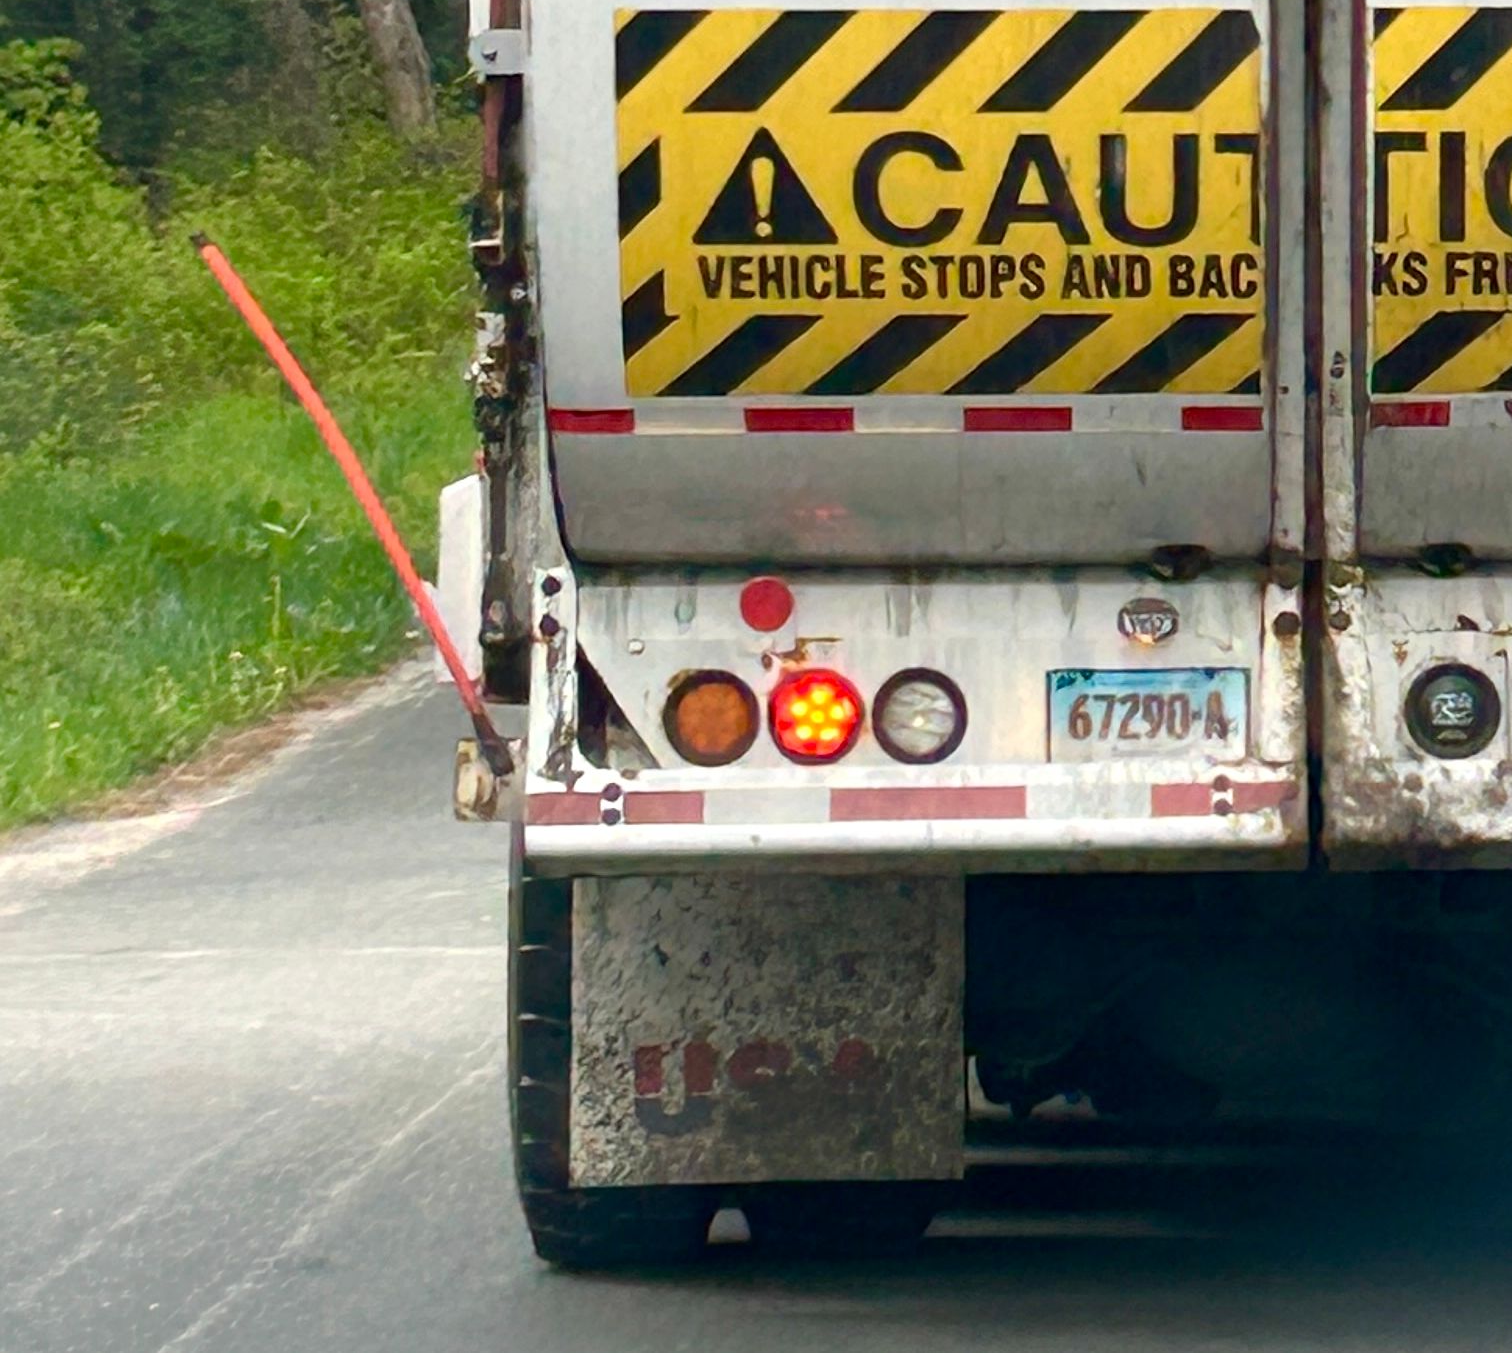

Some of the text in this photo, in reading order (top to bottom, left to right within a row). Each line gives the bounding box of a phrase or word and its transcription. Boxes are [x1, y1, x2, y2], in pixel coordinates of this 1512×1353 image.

[697, 252, 886, 300] VEHICLE
[900, 252, 1047, 300] STOPS
[1060, 252, 1152, 300] AND
